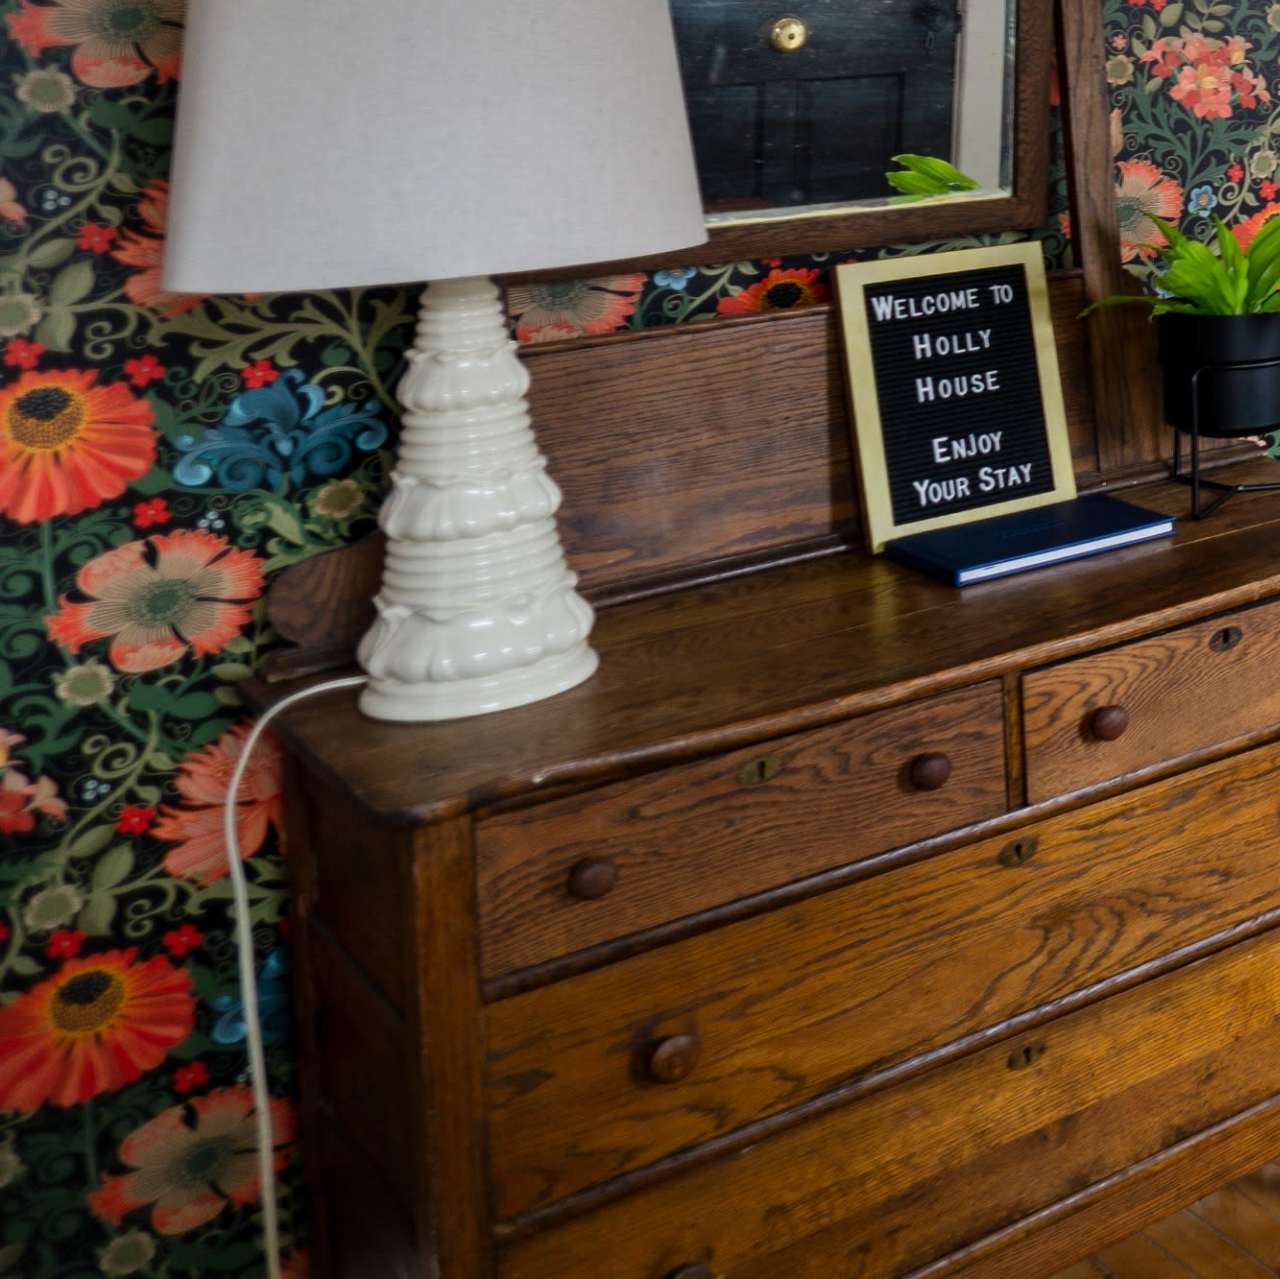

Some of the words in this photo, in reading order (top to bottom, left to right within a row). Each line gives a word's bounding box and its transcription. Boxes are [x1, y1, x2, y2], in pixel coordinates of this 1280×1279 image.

[871, 288, 980, 322] WELCOME
[989, 284, 1014, 305] TO
[913, 328, 993, 359] HOLLY
[915, 370, 1000, 402] HOUSE
[932, 431, 1002, 463] ENJOY
[913, 476, 970, 507] YOUR
[978, 463, 1033, 492] STAY
